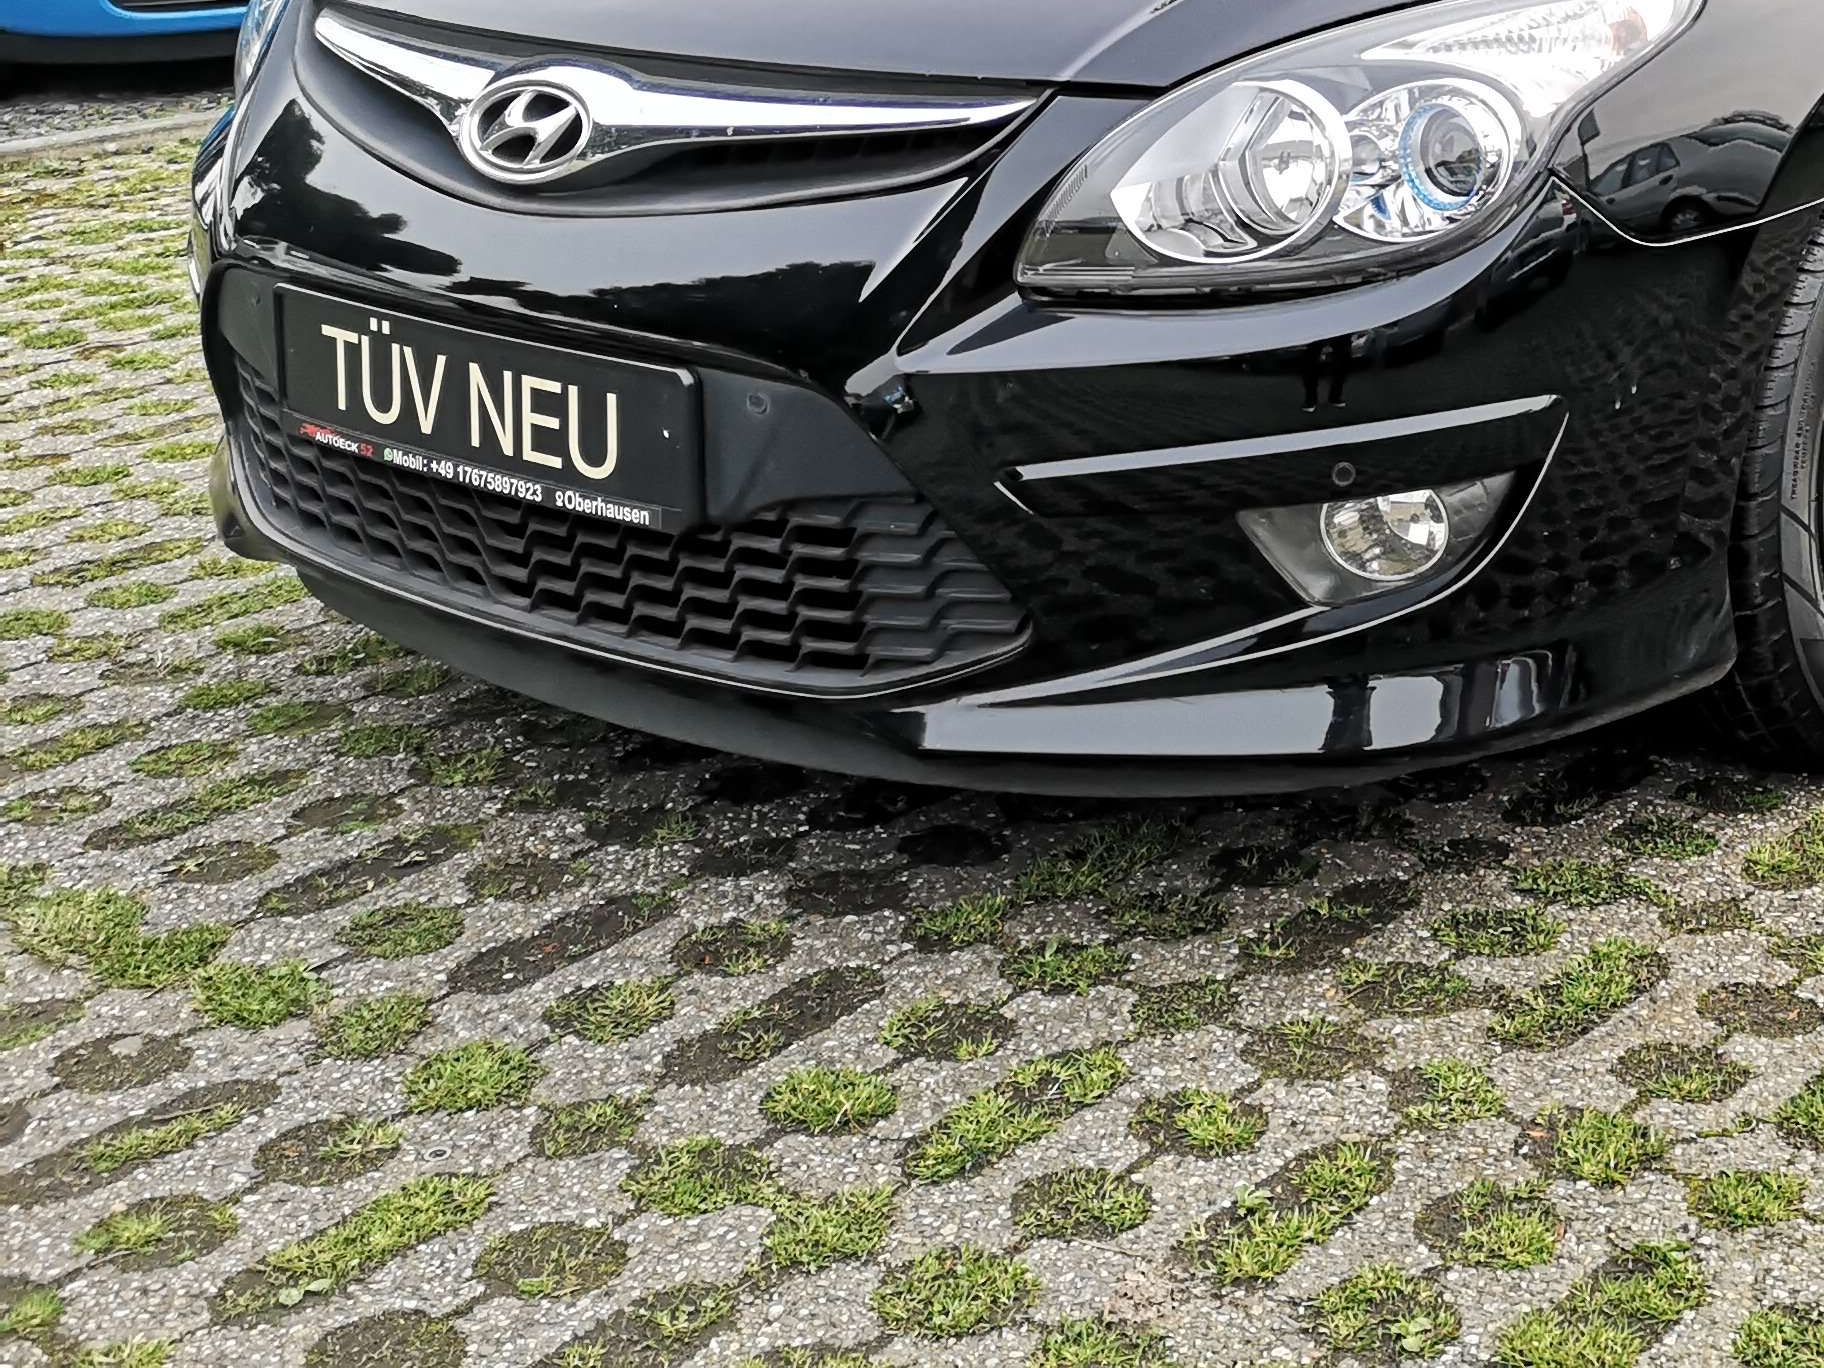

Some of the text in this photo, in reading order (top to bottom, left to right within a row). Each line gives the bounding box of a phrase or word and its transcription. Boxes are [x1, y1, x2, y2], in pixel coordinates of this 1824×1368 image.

[320, 316, 618, 480] TÜV NEU
[315, 431, 375, 457] AUTOECK 52
[392, 448, 543, 503] Mobil: +49 17675897923
[564, 490, 650, 526] Oberhausen
